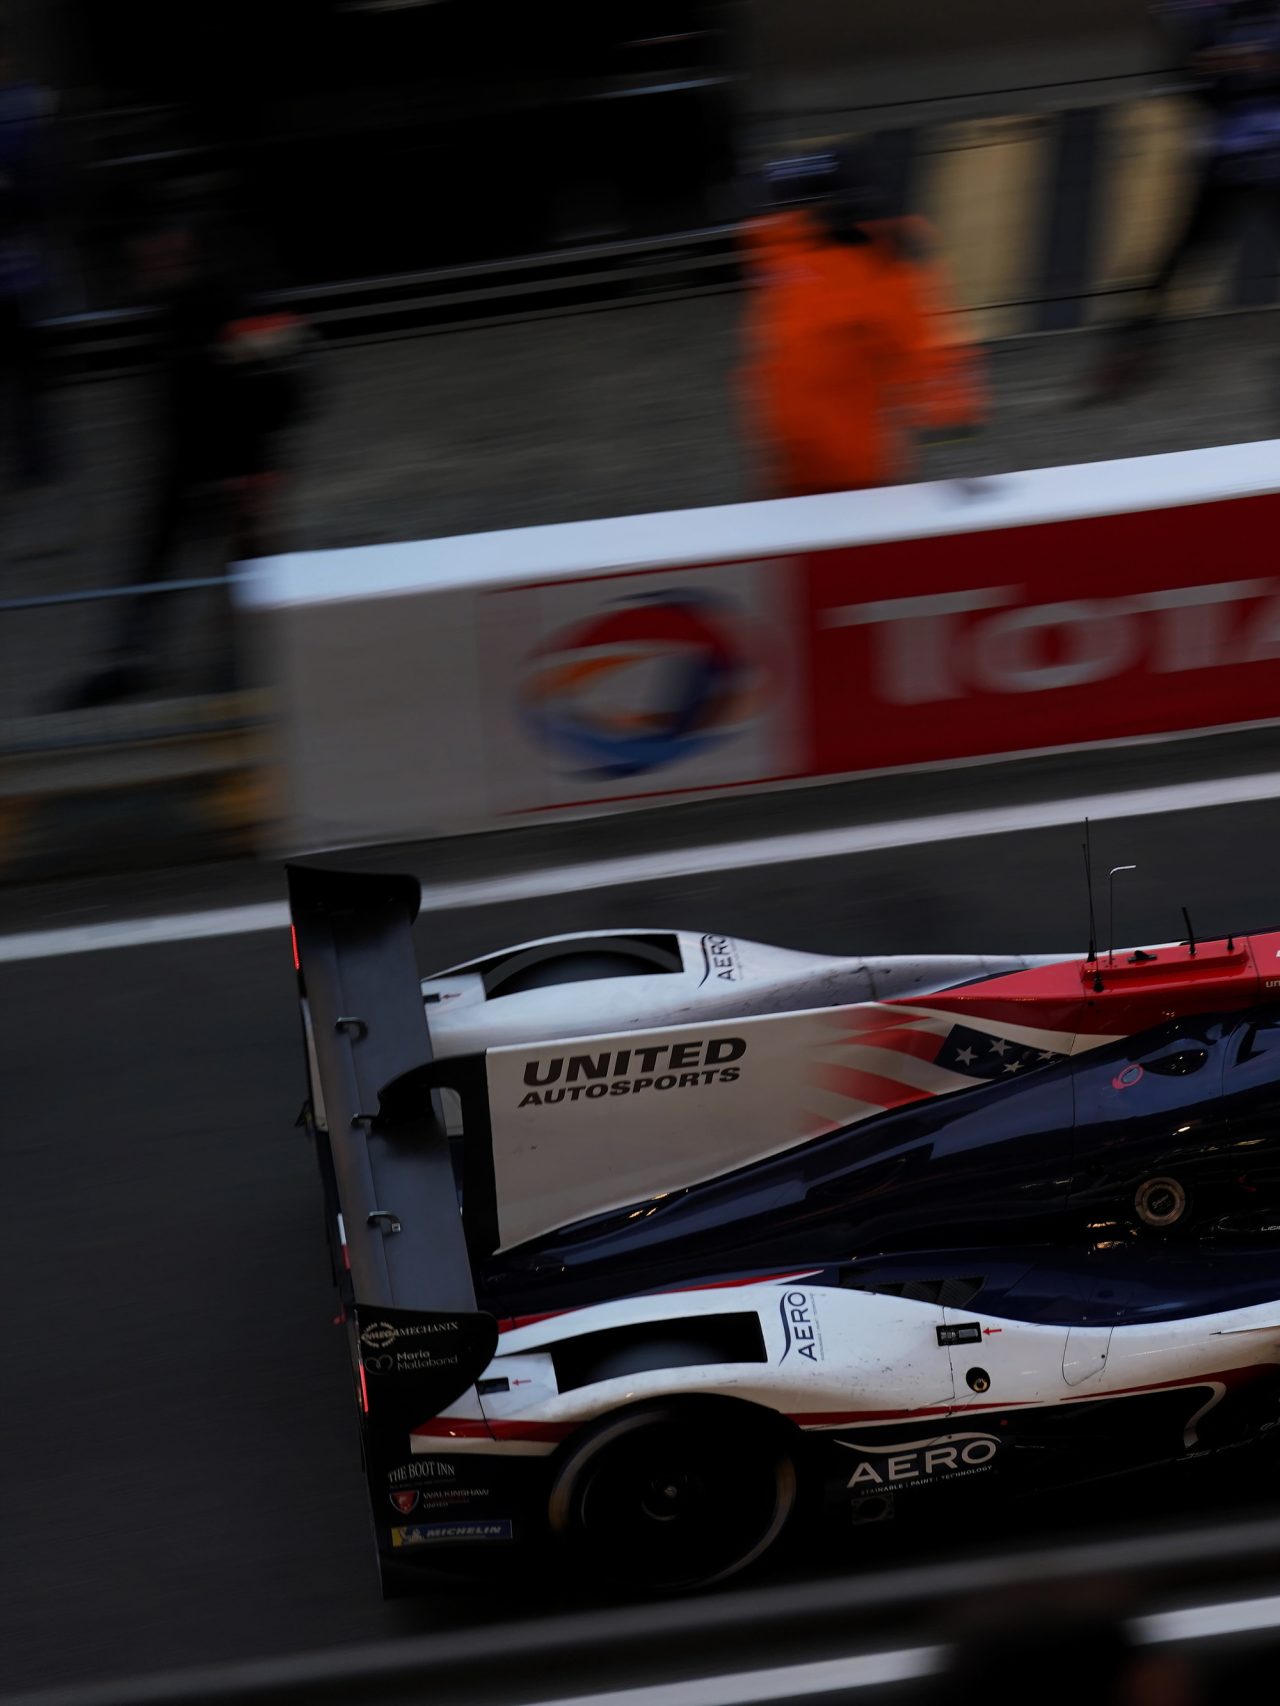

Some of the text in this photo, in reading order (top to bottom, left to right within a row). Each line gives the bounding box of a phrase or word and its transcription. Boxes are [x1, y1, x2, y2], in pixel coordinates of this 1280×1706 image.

[523, 1037, 747, 1086] UNITED
[518, 1066, 740, 1108] AUTOSPORTS
[787, 1292, 818, 1362] AERO
[388, 1466, 407, 1484] THE
[409, 1461, 435, 1479] BOOT
[437, 1461, 456, 1477] INN
[846, 1440, 997, 1489] AERO
[427, 1526, 501, 1538] MICHELIN
